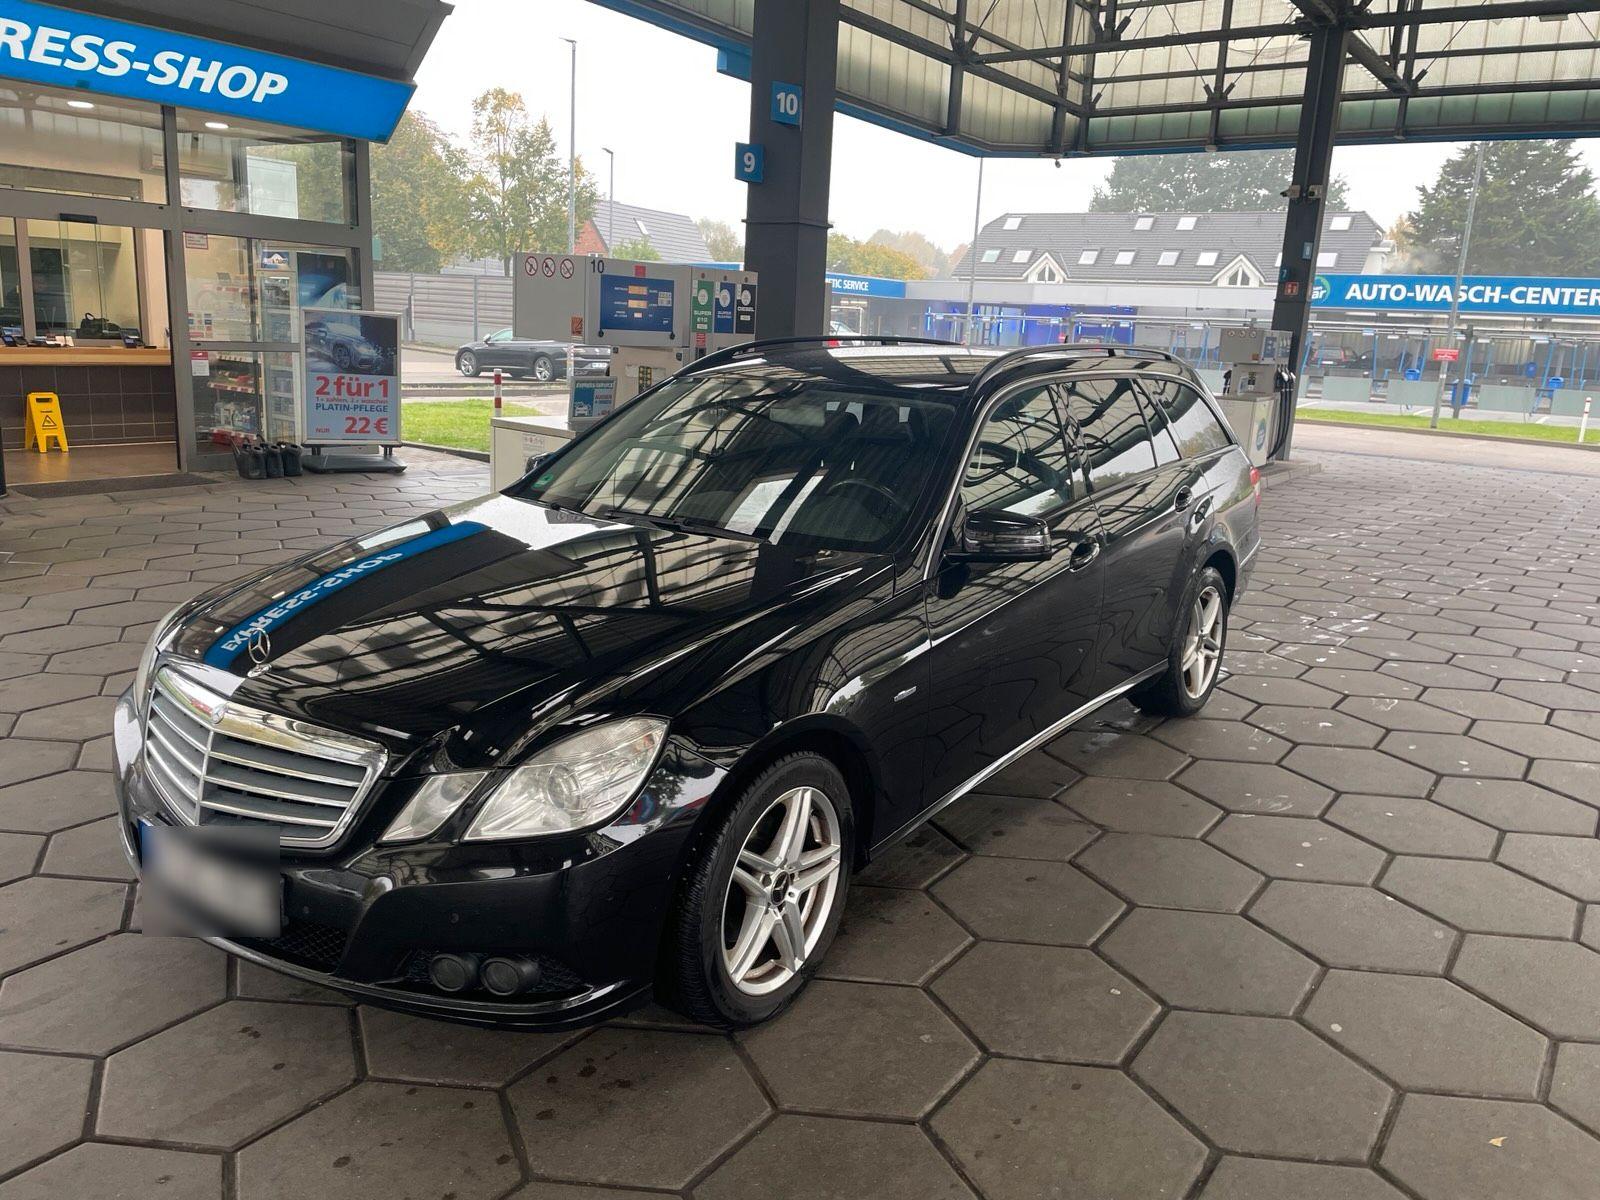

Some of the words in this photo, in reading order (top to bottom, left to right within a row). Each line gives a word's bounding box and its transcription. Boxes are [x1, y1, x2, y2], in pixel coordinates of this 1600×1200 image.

[776, 92, 798, 115] 10
[743, 152, 756, 173] 9
[591, 259, 605, 274] 10
[843, 280, 869, 291] SERVICE
[1345, 284, 1600, 307] AUTO-WASCH-CENTER
[315, 376, 330, 396] 2
[334, 375, 374, 398] für
[378, 379, 388, 398] 1
[315, 403, 388, 413] PLATIN-PFLEGE
[345, 416, 371, 434] 22
[373, 417, 388, 435] €
